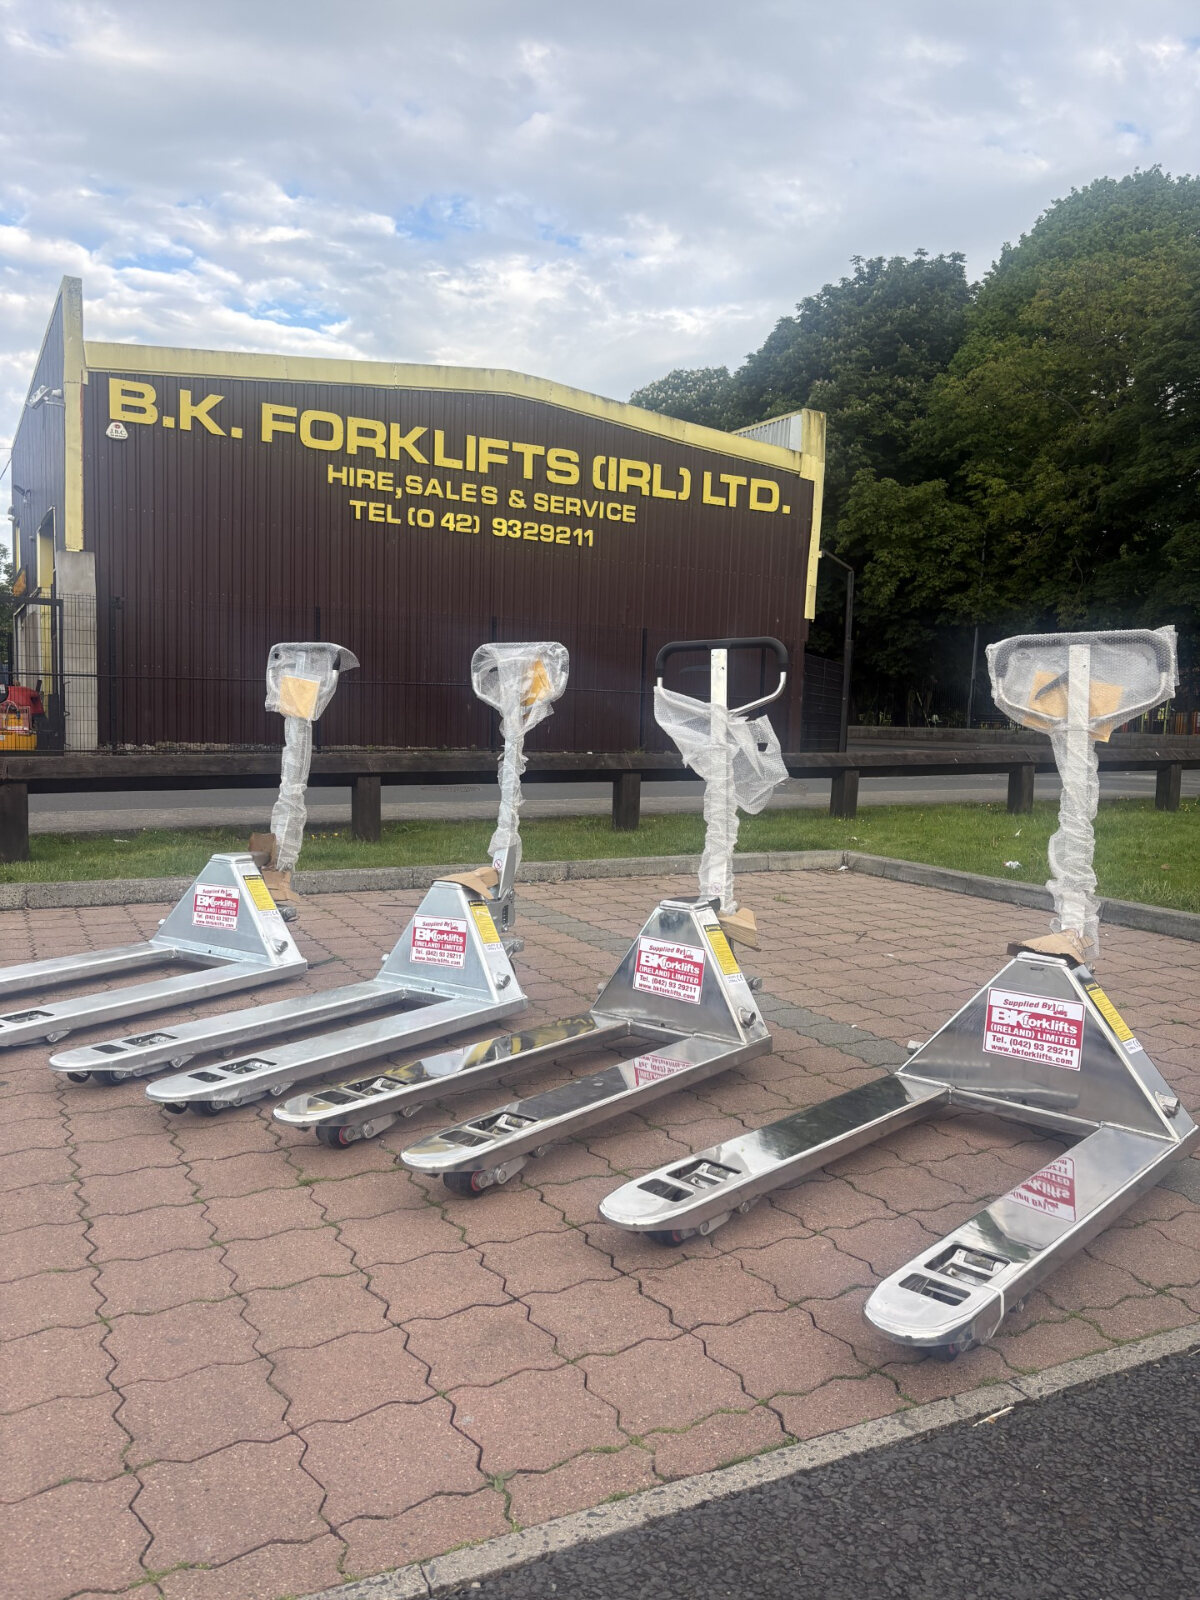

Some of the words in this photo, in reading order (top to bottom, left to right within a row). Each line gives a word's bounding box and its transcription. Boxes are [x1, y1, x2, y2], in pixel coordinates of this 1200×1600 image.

[108, 377, 243, 439] B.K.
[261, 402, 580, 486] FORKLIFTS
[592, 455, 692, 501] (IRL)
[702, 471, 791, 515] LTD.
[508, 489, 527, 509] &
[533, 492, 637, 524] SERVICE
[349, 499, 401, 525] TEL
[492, 517, 594, 547] 9329211
[649, 945, 675, 954] Supplied
[675, 947, 684, 955] By
[639, 965, 670, 978] (IRELAND)
[671, 972, 699, 984] LIMITED
[640, 975, 650, 983] Tel.
[651, 977, 668, 987] (042)
[668, 981, 677, 989] 93
[677, 983, 697, 993] 29211
[1003, 998, 1040, 1009] Supplied
[1041, 1002, 1054, 1012] By
[990, 1023, 1036, 1039] (IRELAND)
[1037, 1032, 1077, 1046] LIMITED
[992, 1034, 1007, 1045] Tel.
[1009, 1038, 1032, 1050] (042)
[1033, 1042, 1045, 1052] 93
[1046, 1045, 1074, 1057] 29211
[991, 1044, 1073, 1066] www.bkforklifts.com
